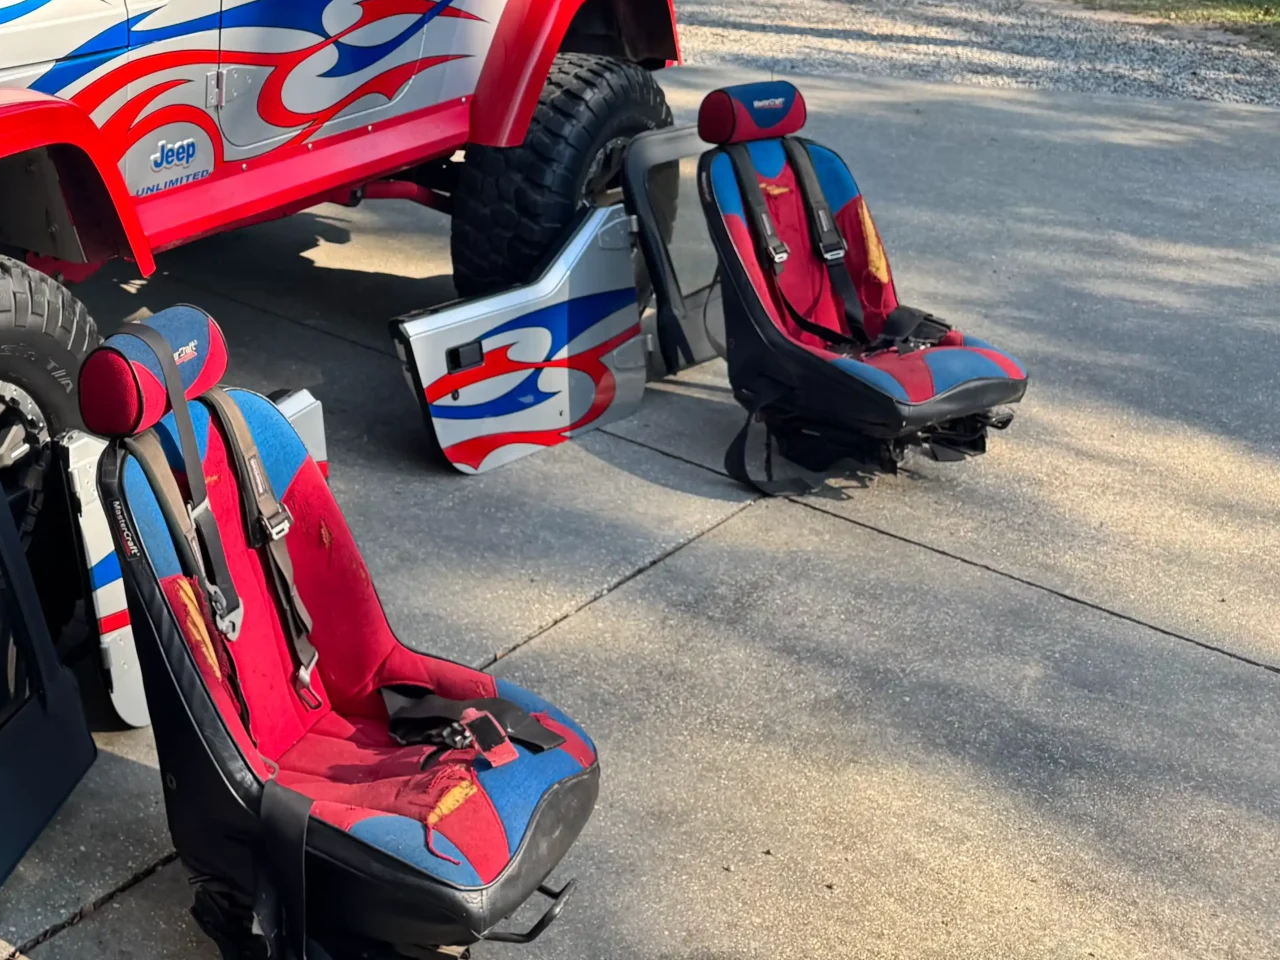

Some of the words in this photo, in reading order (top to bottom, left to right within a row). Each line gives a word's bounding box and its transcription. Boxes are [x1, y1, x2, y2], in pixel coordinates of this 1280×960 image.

[150, 138, 197, 171] Jeep
[135, 169, 210, 197] UNLIMITED
[113, 501, 139, 555] MasterCraft
